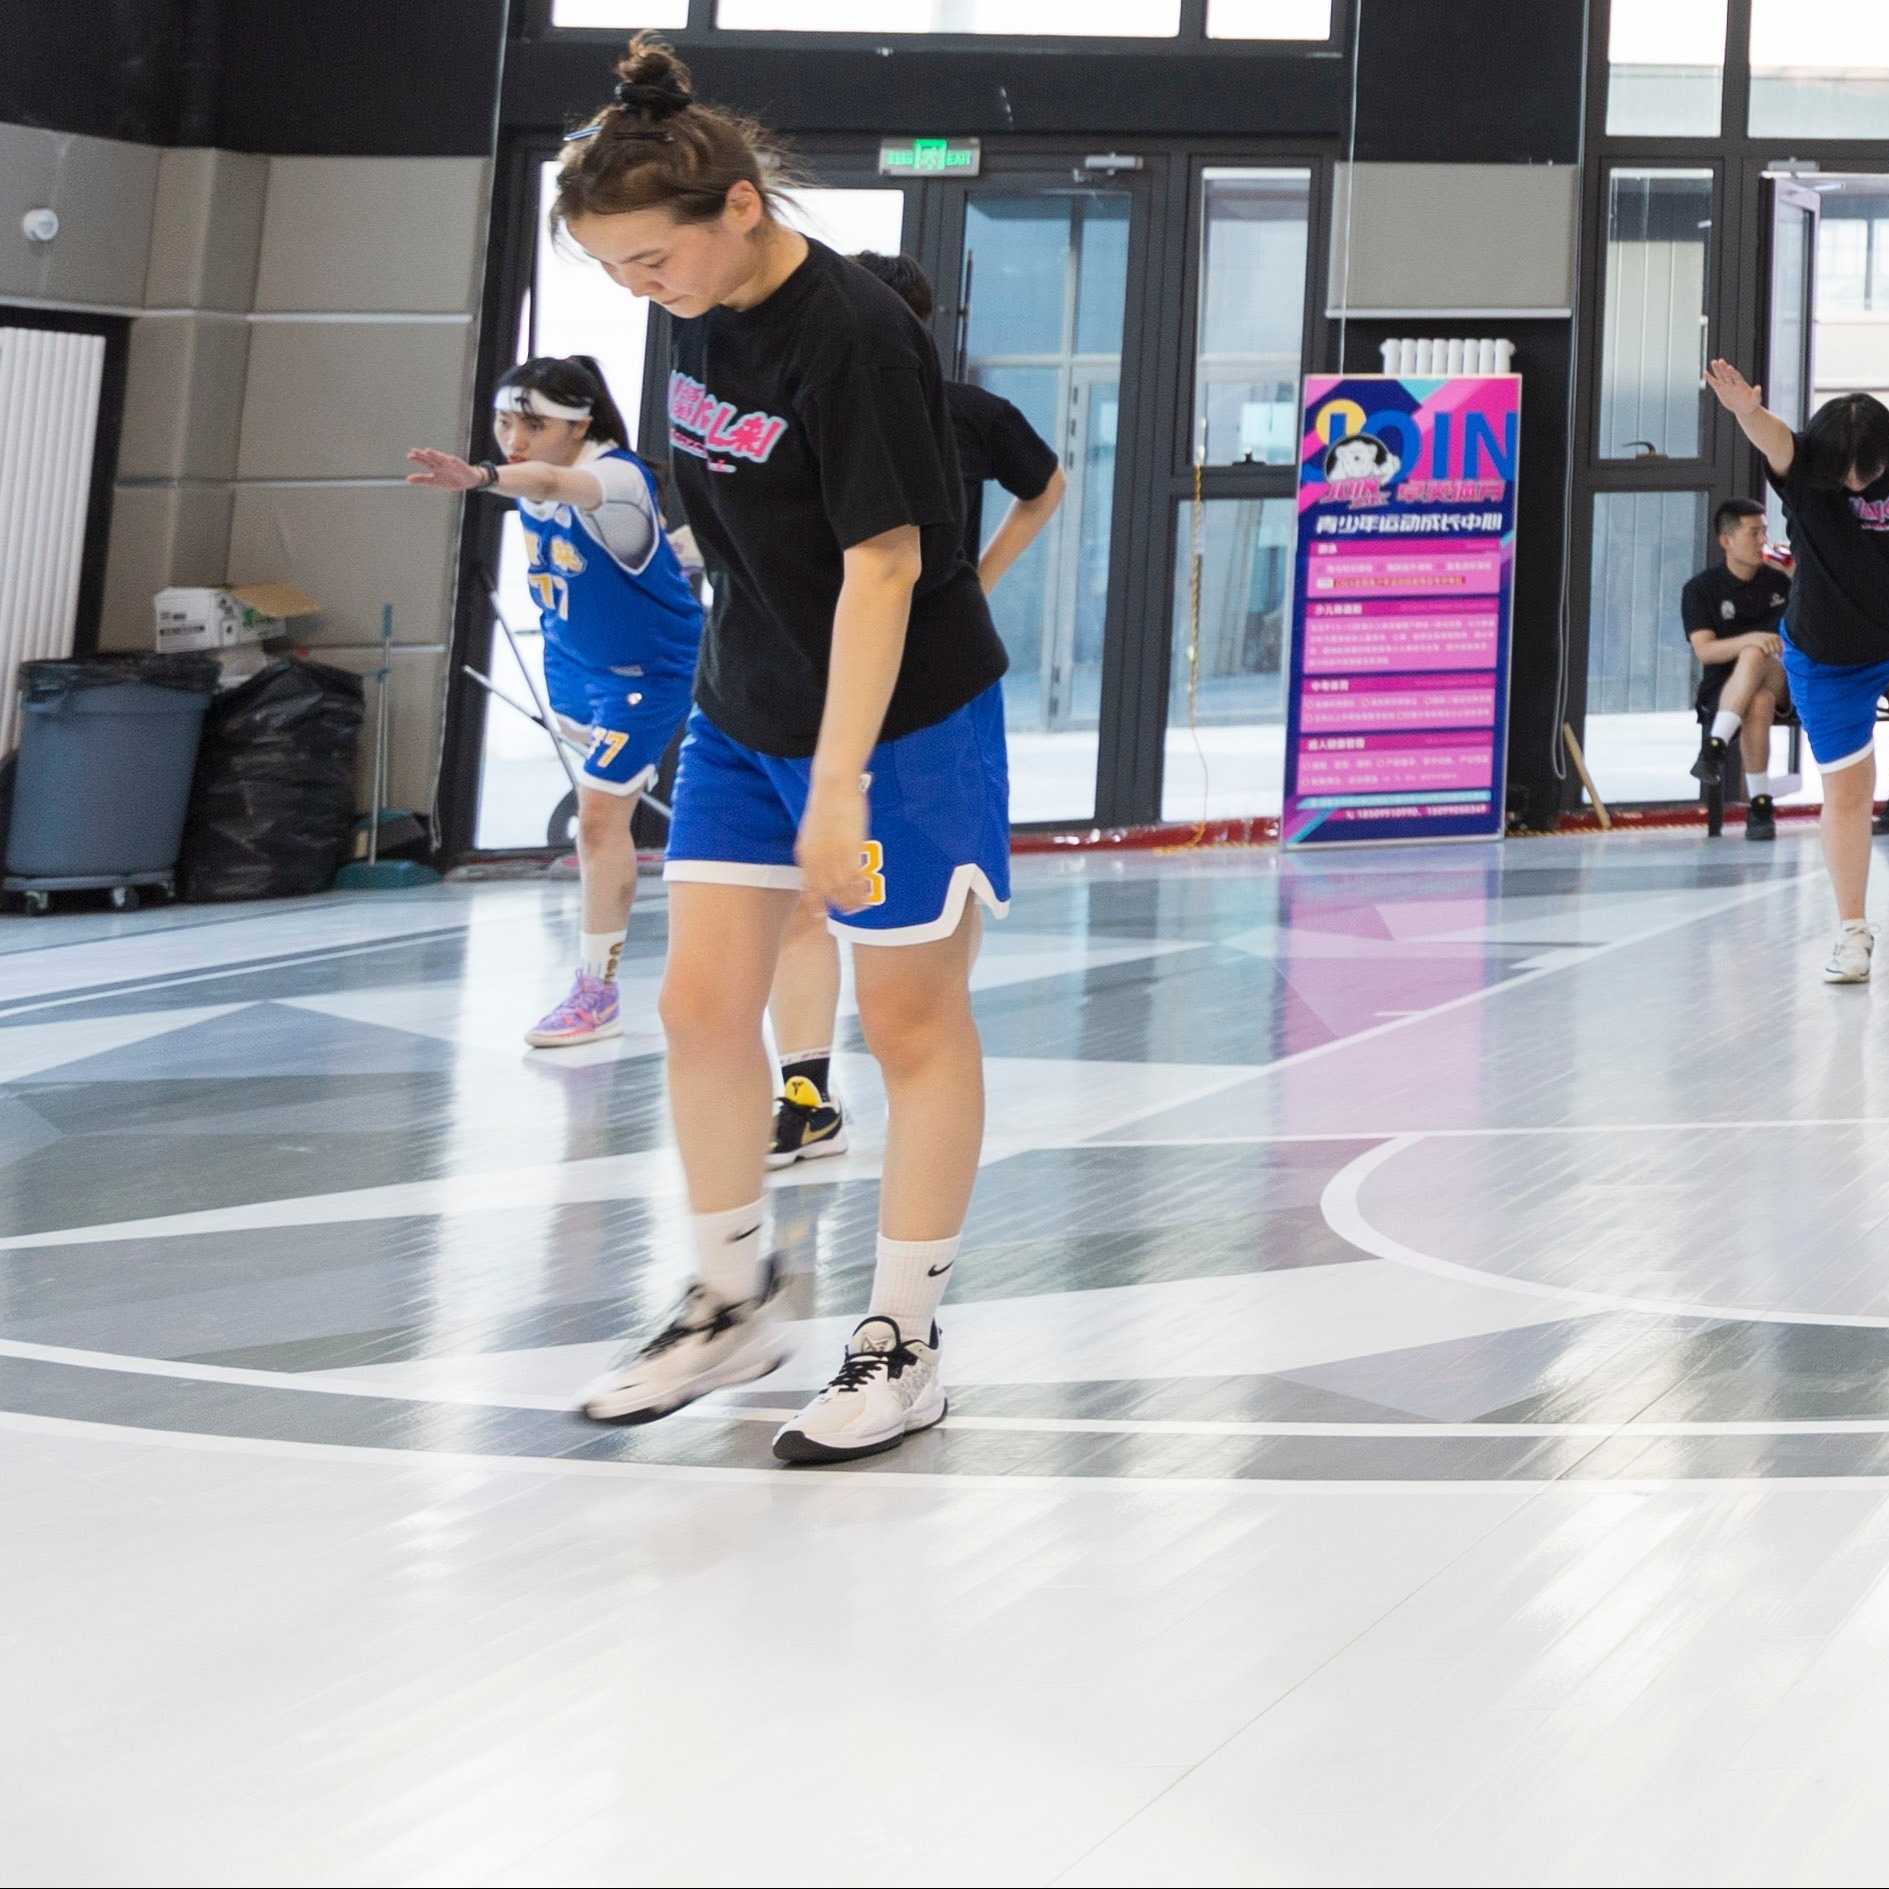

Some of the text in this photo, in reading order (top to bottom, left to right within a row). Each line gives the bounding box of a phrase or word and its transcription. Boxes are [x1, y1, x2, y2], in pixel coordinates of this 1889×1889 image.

[947, 150, 972, 166] EXIT
[1315, 512, 1503, 535] 青少年运动成长中心
